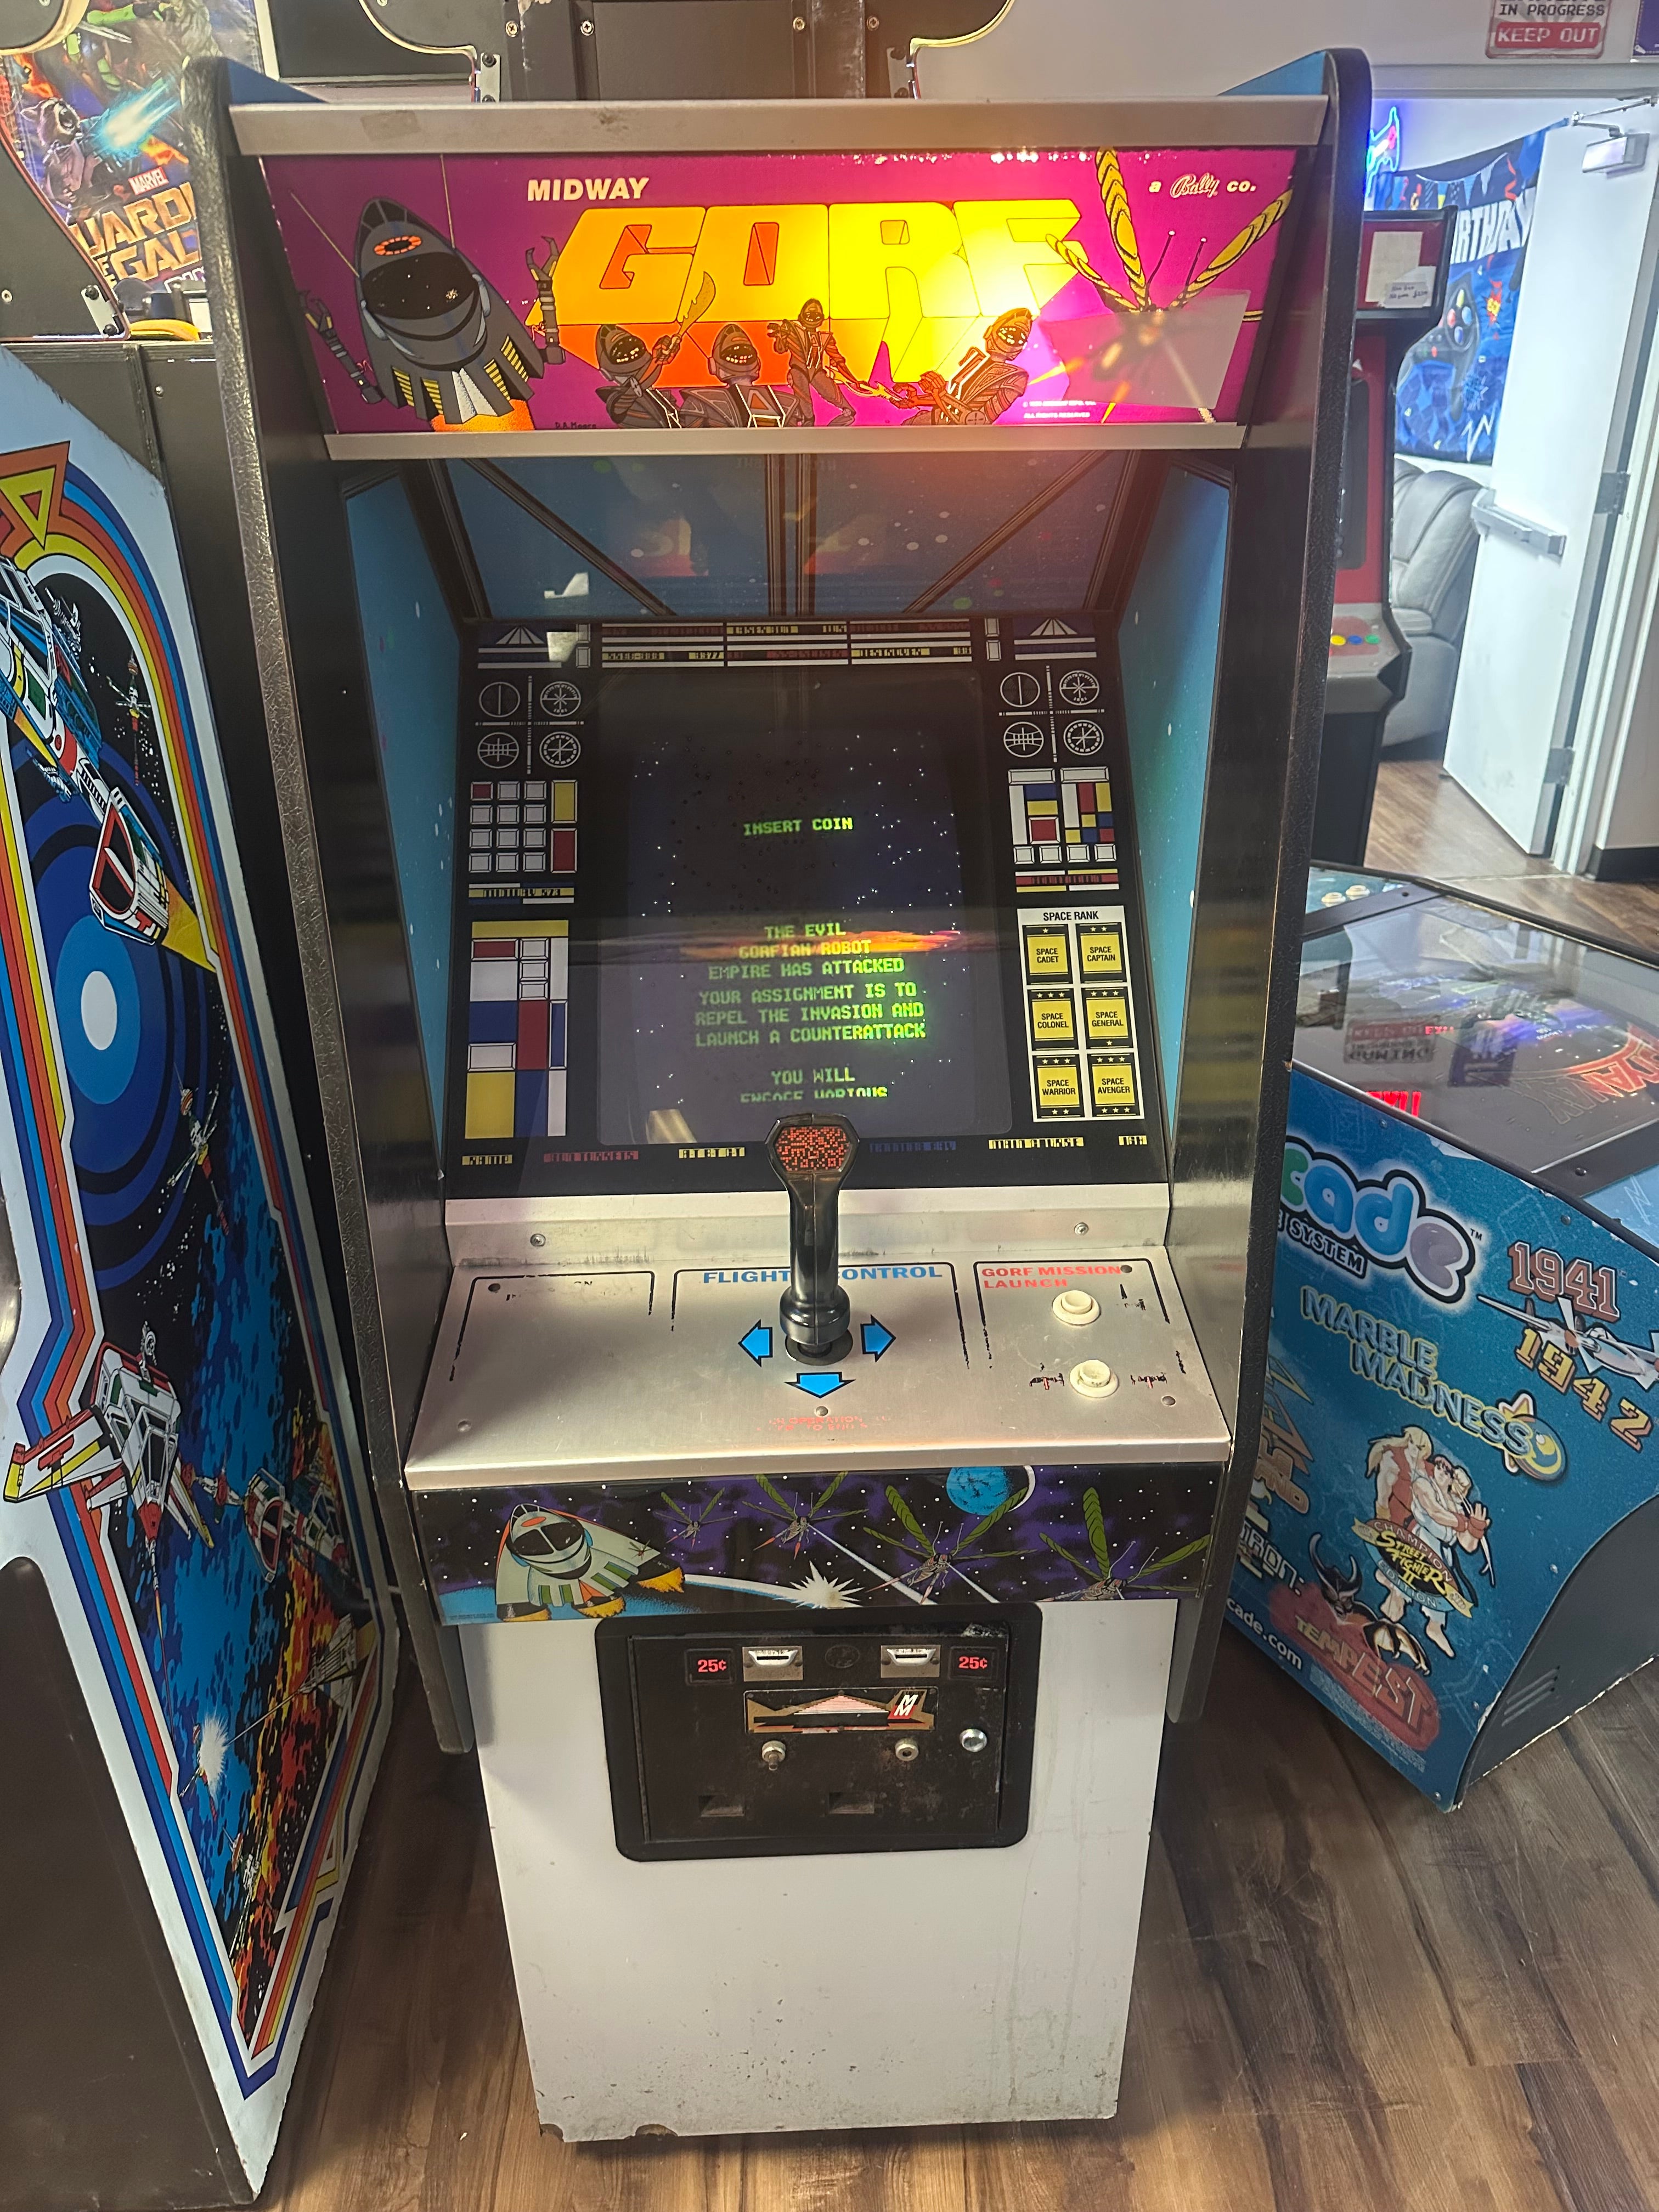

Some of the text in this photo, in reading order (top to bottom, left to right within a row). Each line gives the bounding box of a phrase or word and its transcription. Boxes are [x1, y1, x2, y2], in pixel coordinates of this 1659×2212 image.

[1499, 4, 1605, 16] IN PROGRESS
[1498, 27, 1599, 42] KEEP OUT
[129, 169, 168, 195] MARVEL
[527, 178, 650, 202] MIDWAY
[1149, 172, 1257, 199] a Bally co.
[526, 200, 1087, 368] GORF
[744, 817, 853, 836] INSERT COIN
[1043, 911, 1099, 921] SPACE RANK
[764, 922, 847, 939] THE EVIL
[738, 939, 872, 959] GORFIAN ROBOT
[1036, 947, 1058, 956] SPACE
[1037, 955, 1059, 963] CADET
[1087, 953, 1116, 962] CAPTAIN
[708, 957, 905, 980] EMPIRE HAS ATTACKED
[700, 981, 917, 1006] YOUR ASSIGNMENT IS TO
[695, 1001, 924, 1026] REPEL THE INVASION AND
[1041, 1012, 1063, 1020] SPACE
[1092, 1019, 1124, 1027] GENERAL
[1037, 1020, 1069, 1029] COLONEL
[695, 1023, 926, 1047] LAUNCH A COUNTERATTACK
[771, 1066, 856, 1086] YOU WILL
[1102, 1077, 1124, 1086] SPACE
[1042, 1087, 1076, 1096] WARRIOR
[1098, 1086, 1130, 1094] AVENGER
[1289, 1218, 1364, 1275] SYSTEM
[703, 1266, 943, 1284] FLIGHT ONTROL
[982, 1265, 1122, 1277] GORF MISSION
[984, 1279, 1068, 1289] LAUNCH
[1508, 1241, 1621, 1323] 1941
[1302, 1288, 1437, 1379] MARBLE
[1352, 1341, 1533, 1457] MADNESS
[1516, 1328, 1653, 1453] 1942
[1374, 1521, 1452, 1582] CHAMPION
[1376, 1531, 1427, 1561] STREET
[1386, 1547, 1447, 1595] FIGHTER
[1378, 1560, 1437, 1609] EDITION
[697, 1658, 727, 1672] 25¢
[958, 1656, 988, 1669] 25¢
[1295, 1615, 1431, 1730] TEMPEST
